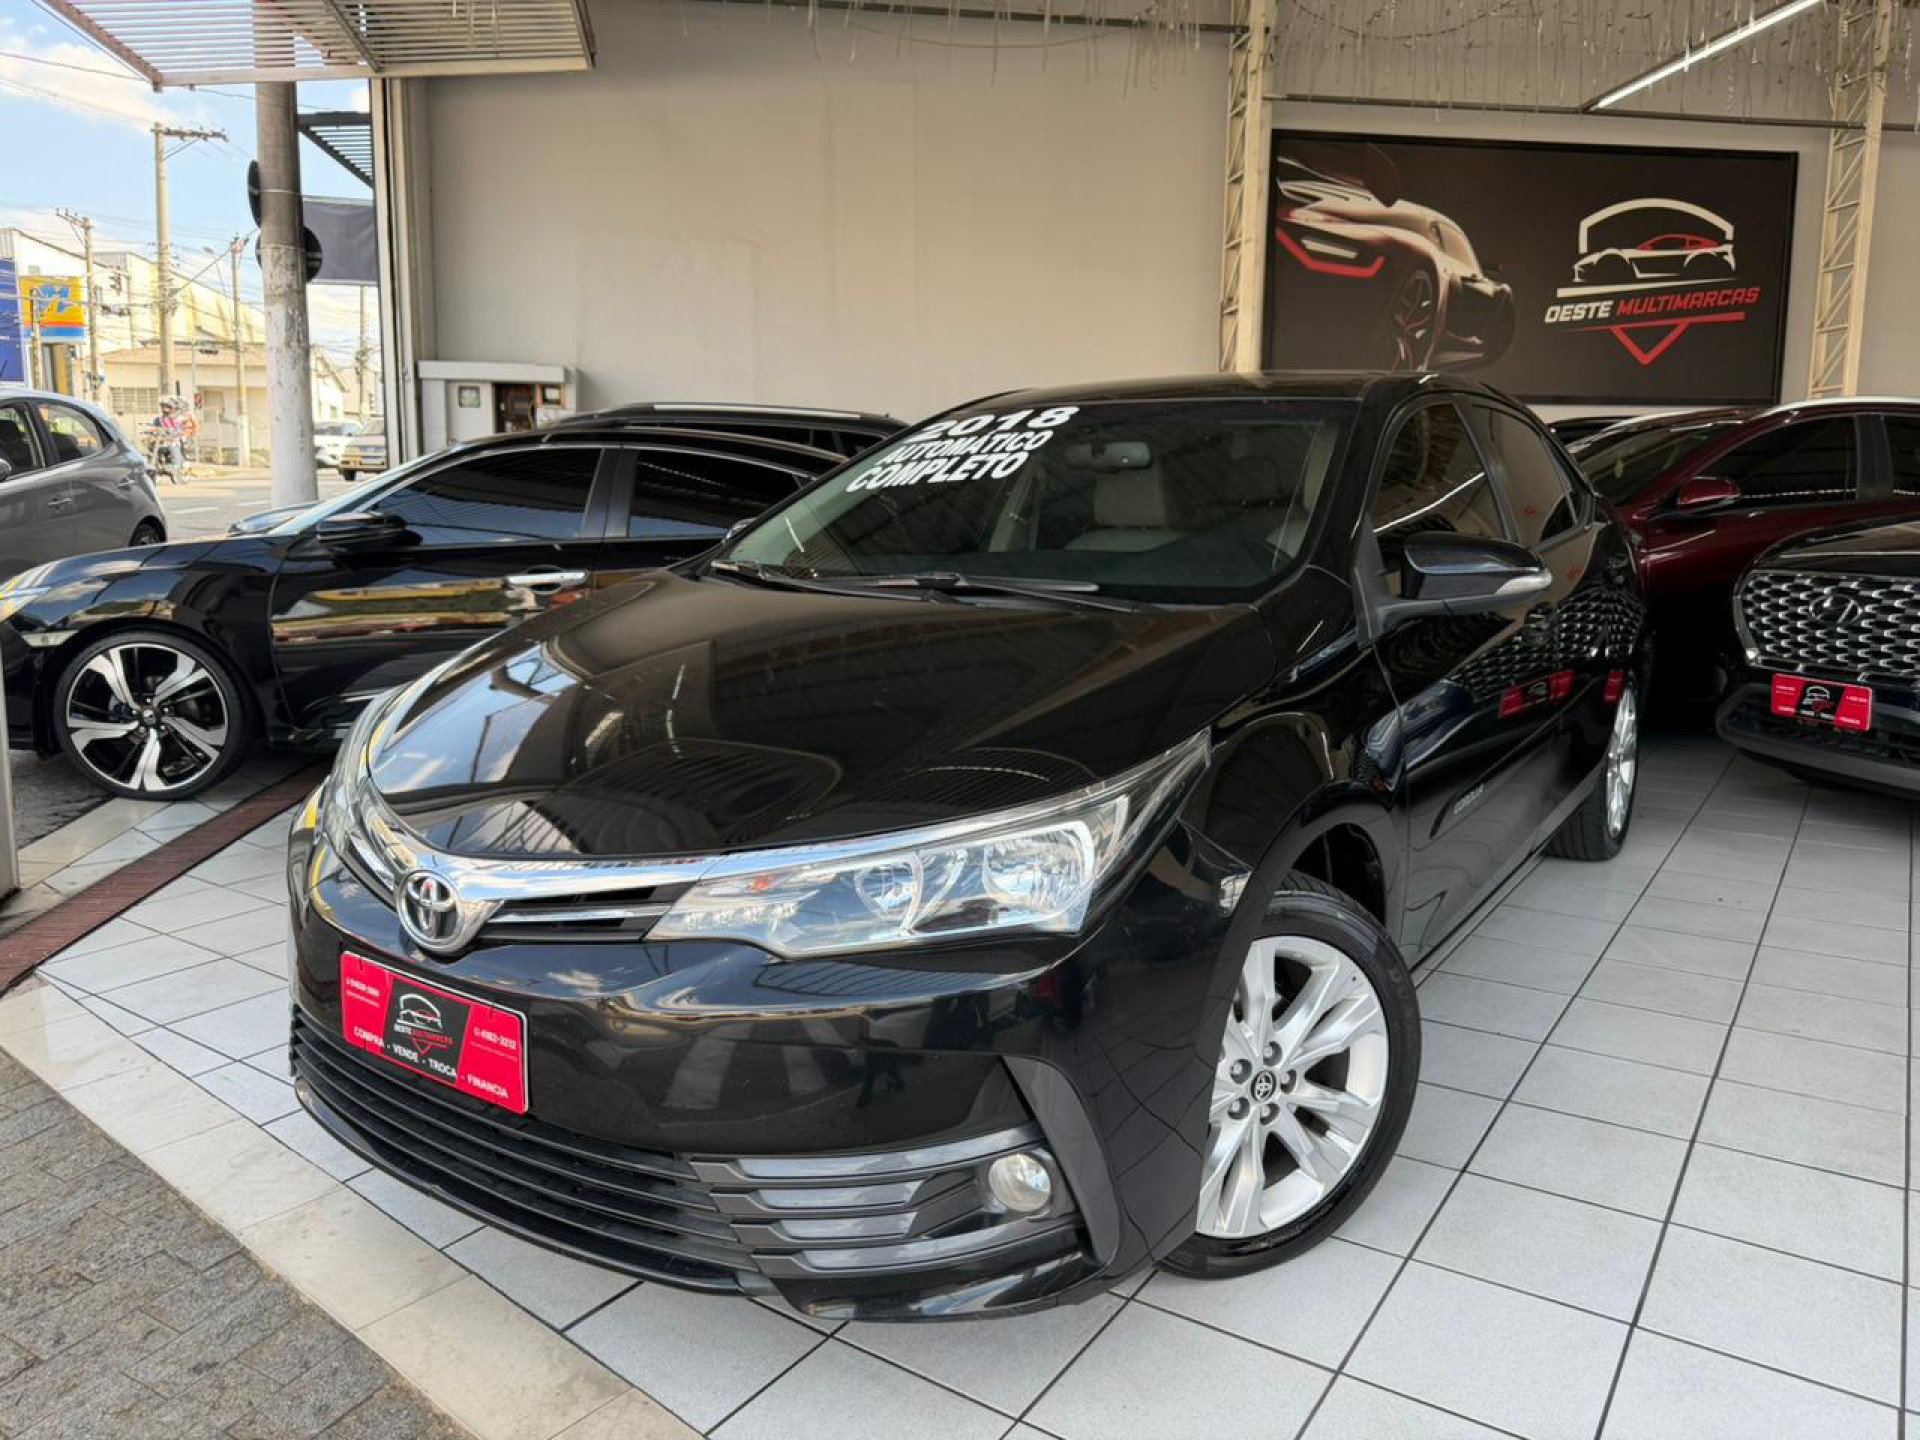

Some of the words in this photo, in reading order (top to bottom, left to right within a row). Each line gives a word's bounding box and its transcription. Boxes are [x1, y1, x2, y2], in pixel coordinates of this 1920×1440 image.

[1544, 300, 1614, 324] OESTE
[1616, 287, 1761, 317] MULTIMARCAS
[902, 406, 1080, 444] 2018
[846, 452, 1029, 493] COMPLETO
[353, 1026, 385, 1048] COMPRA
[428, 1058, 458, 1078] TROCA
[466, 1073, 509, 1099] FINANCIA
